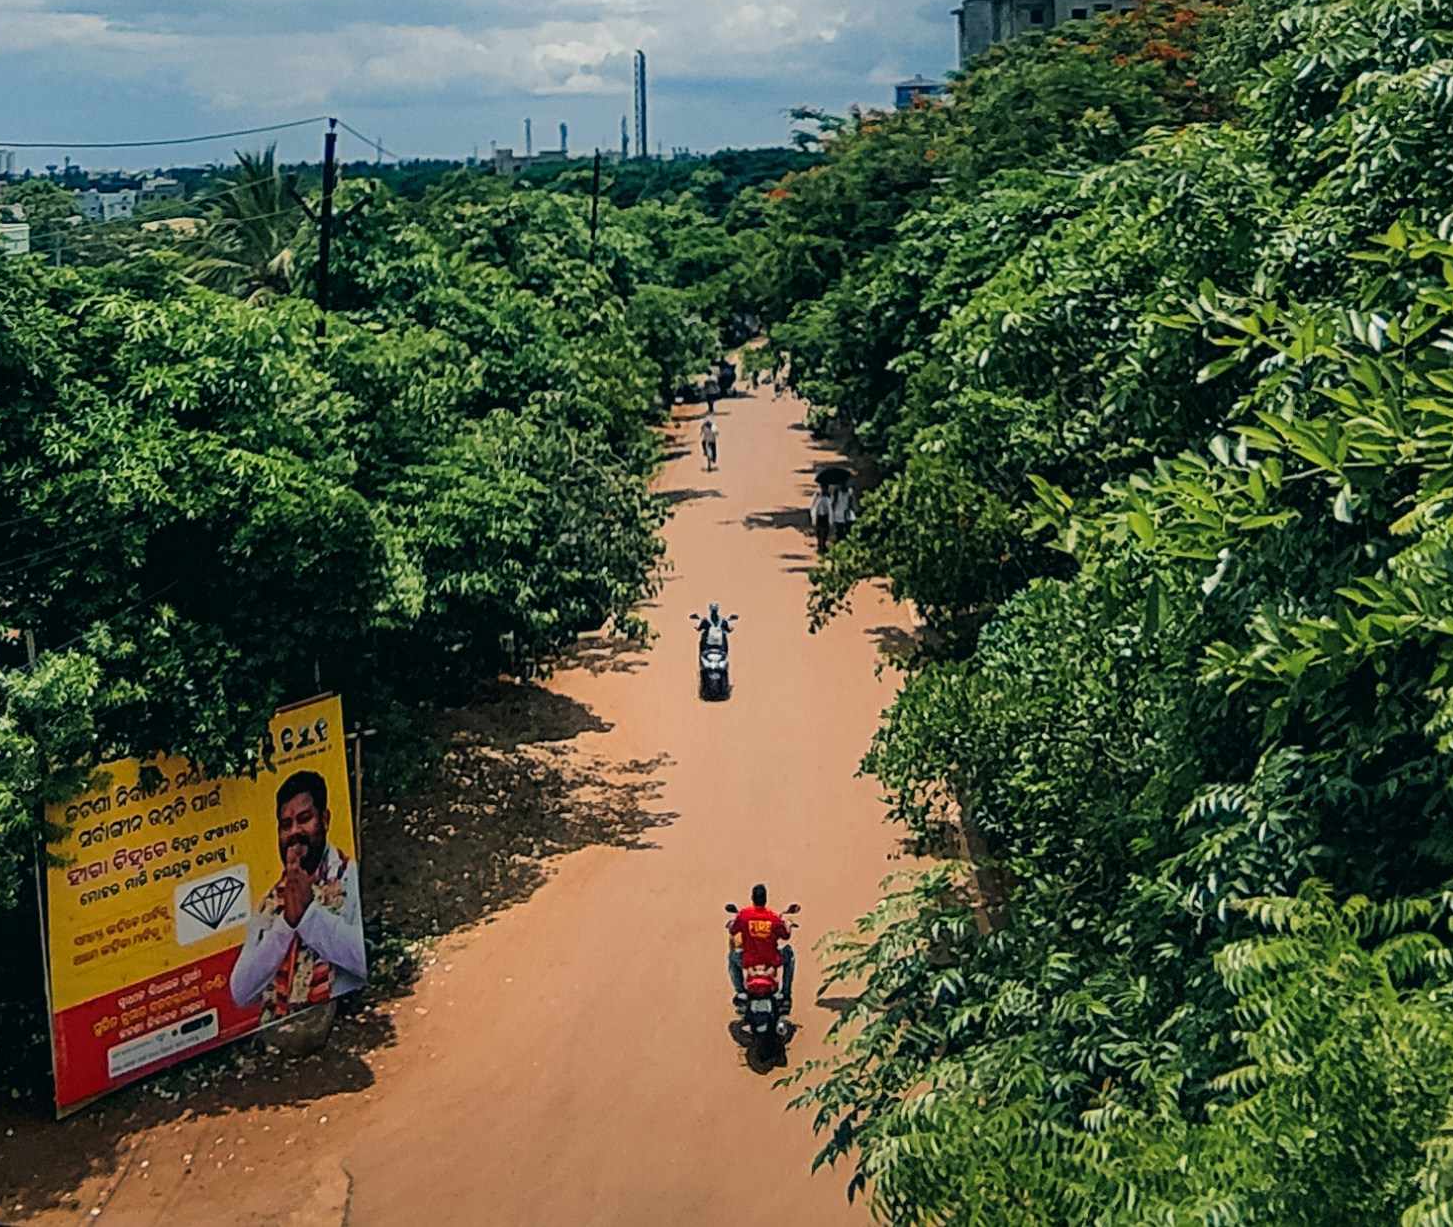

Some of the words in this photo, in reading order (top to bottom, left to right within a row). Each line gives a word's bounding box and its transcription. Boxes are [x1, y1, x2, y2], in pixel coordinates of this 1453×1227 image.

[148, 796, 187, 826] ଉନ୍ନତି
[191, 783, 222, 812] ପାଇଁ
[67, 860, 108, 886] ହୀରା
[112, 841, 168, 871] ଚିହ୍ନରେ
